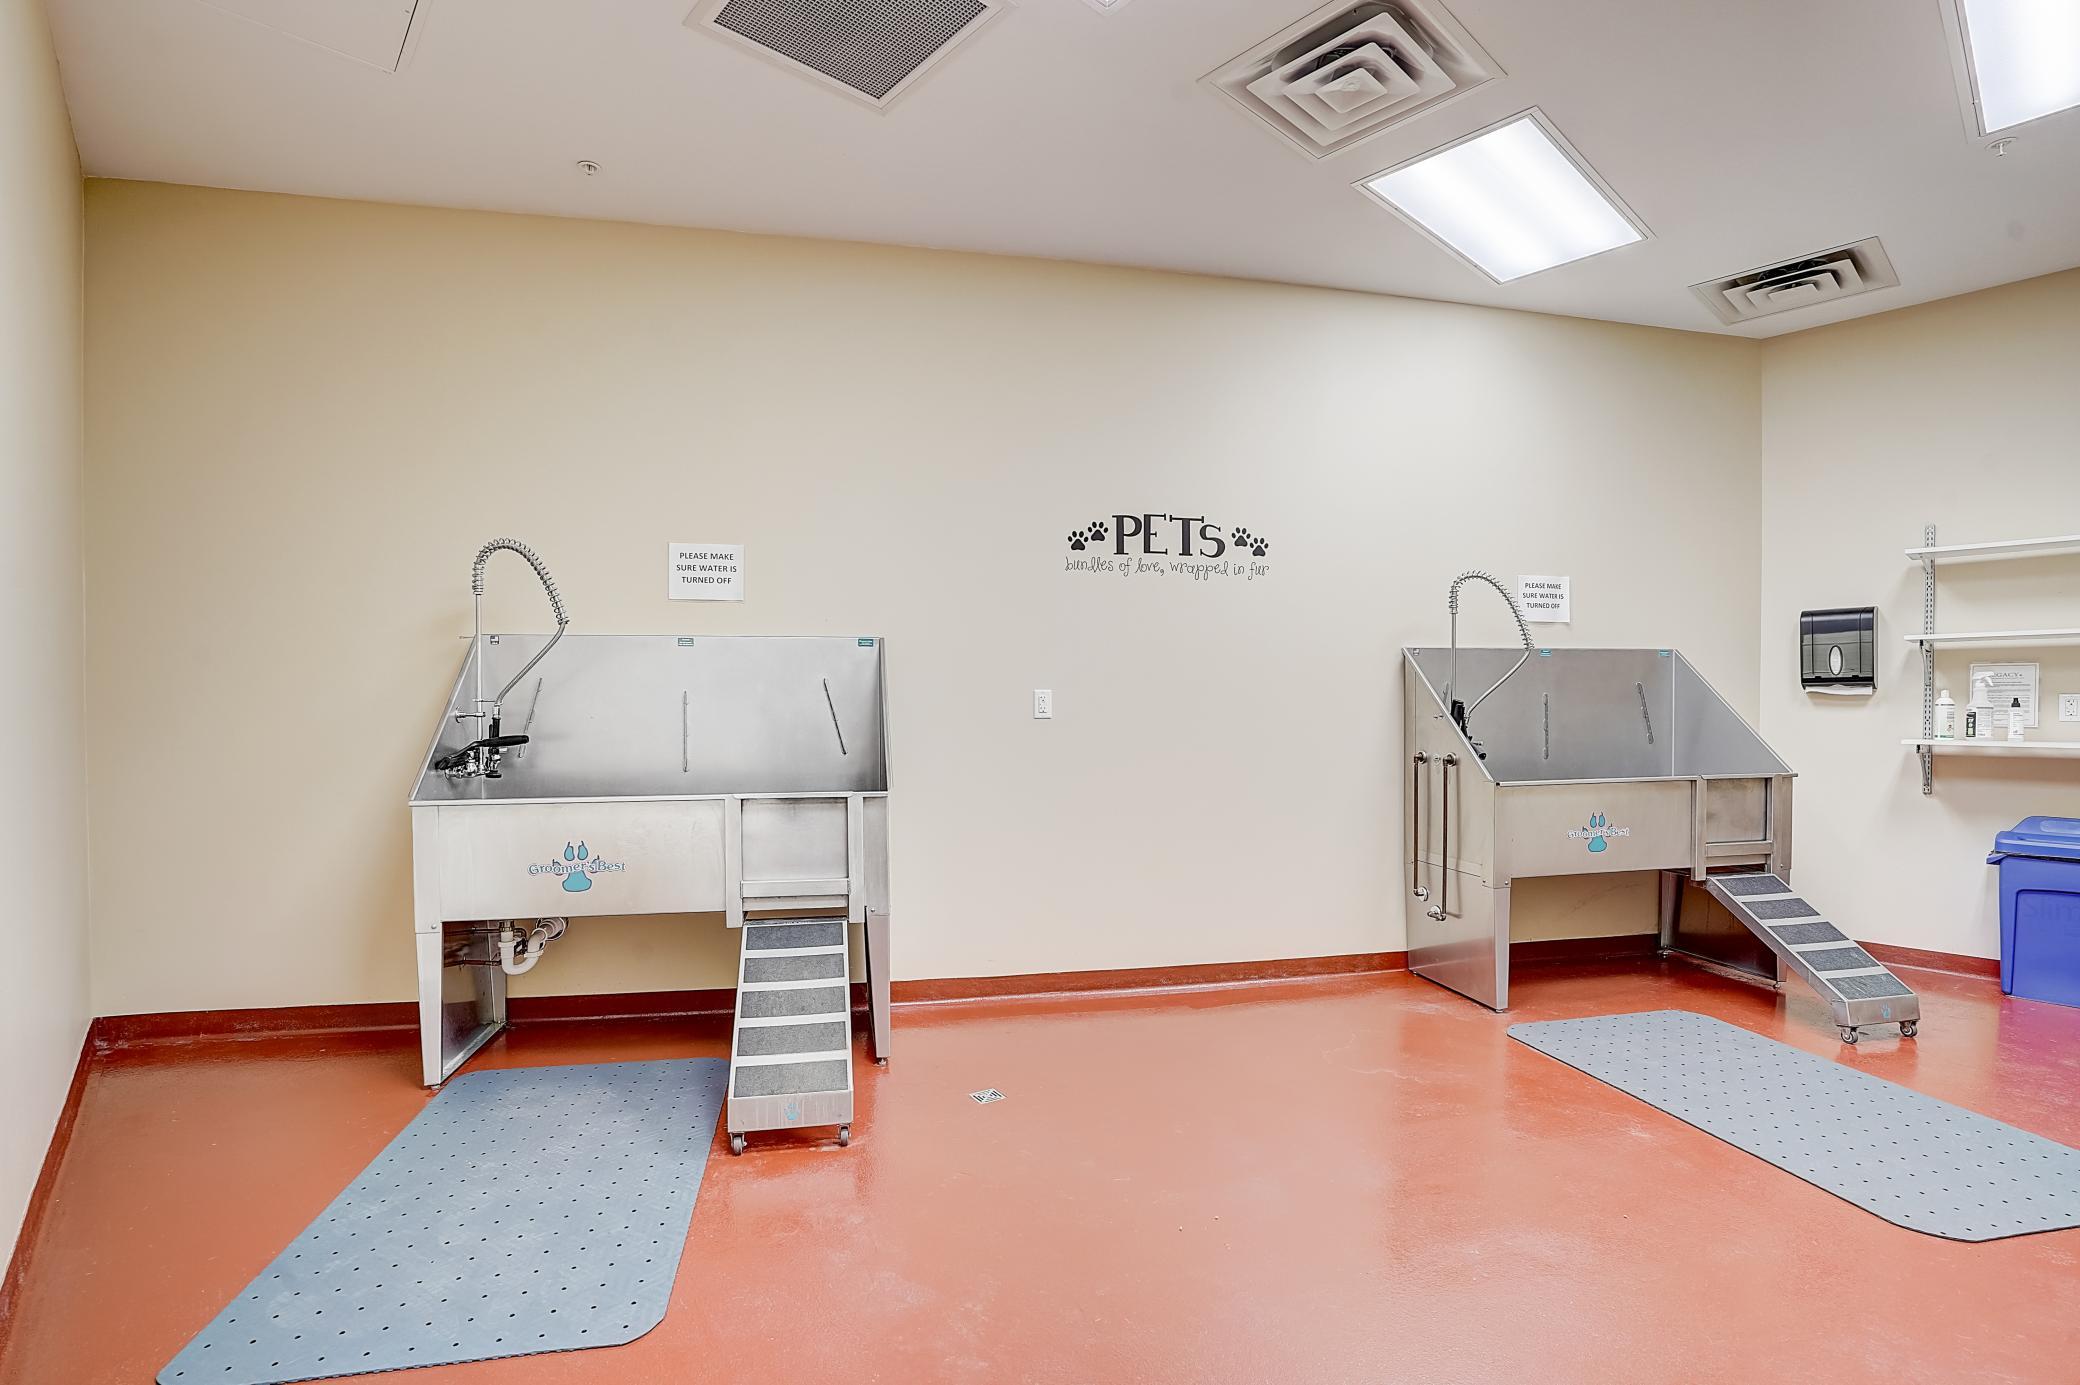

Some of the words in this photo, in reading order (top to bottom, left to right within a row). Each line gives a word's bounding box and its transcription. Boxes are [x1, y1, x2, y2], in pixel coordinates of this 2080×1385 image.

[1111, 513, 1226, 558] PETS
[679, 552, 708, 560] PLEASE
[676, 564, 697, 572] SURE
[730, 565, 737, 573] IS
[1064, 556, 1114, 573] bundles
[1118, 557, 1132, 577] of
[1135, 557, 1164, 576] love,
[1169, 560, 1228, 580] wrapped
[1233, 563, 1245, 576] in
[1247, 561, 1270, 580] fur
[681, 576, 715, 584] TURNED
[528, 861, 596, 876] Groomer's
[597, 860, 626, 872] Best
